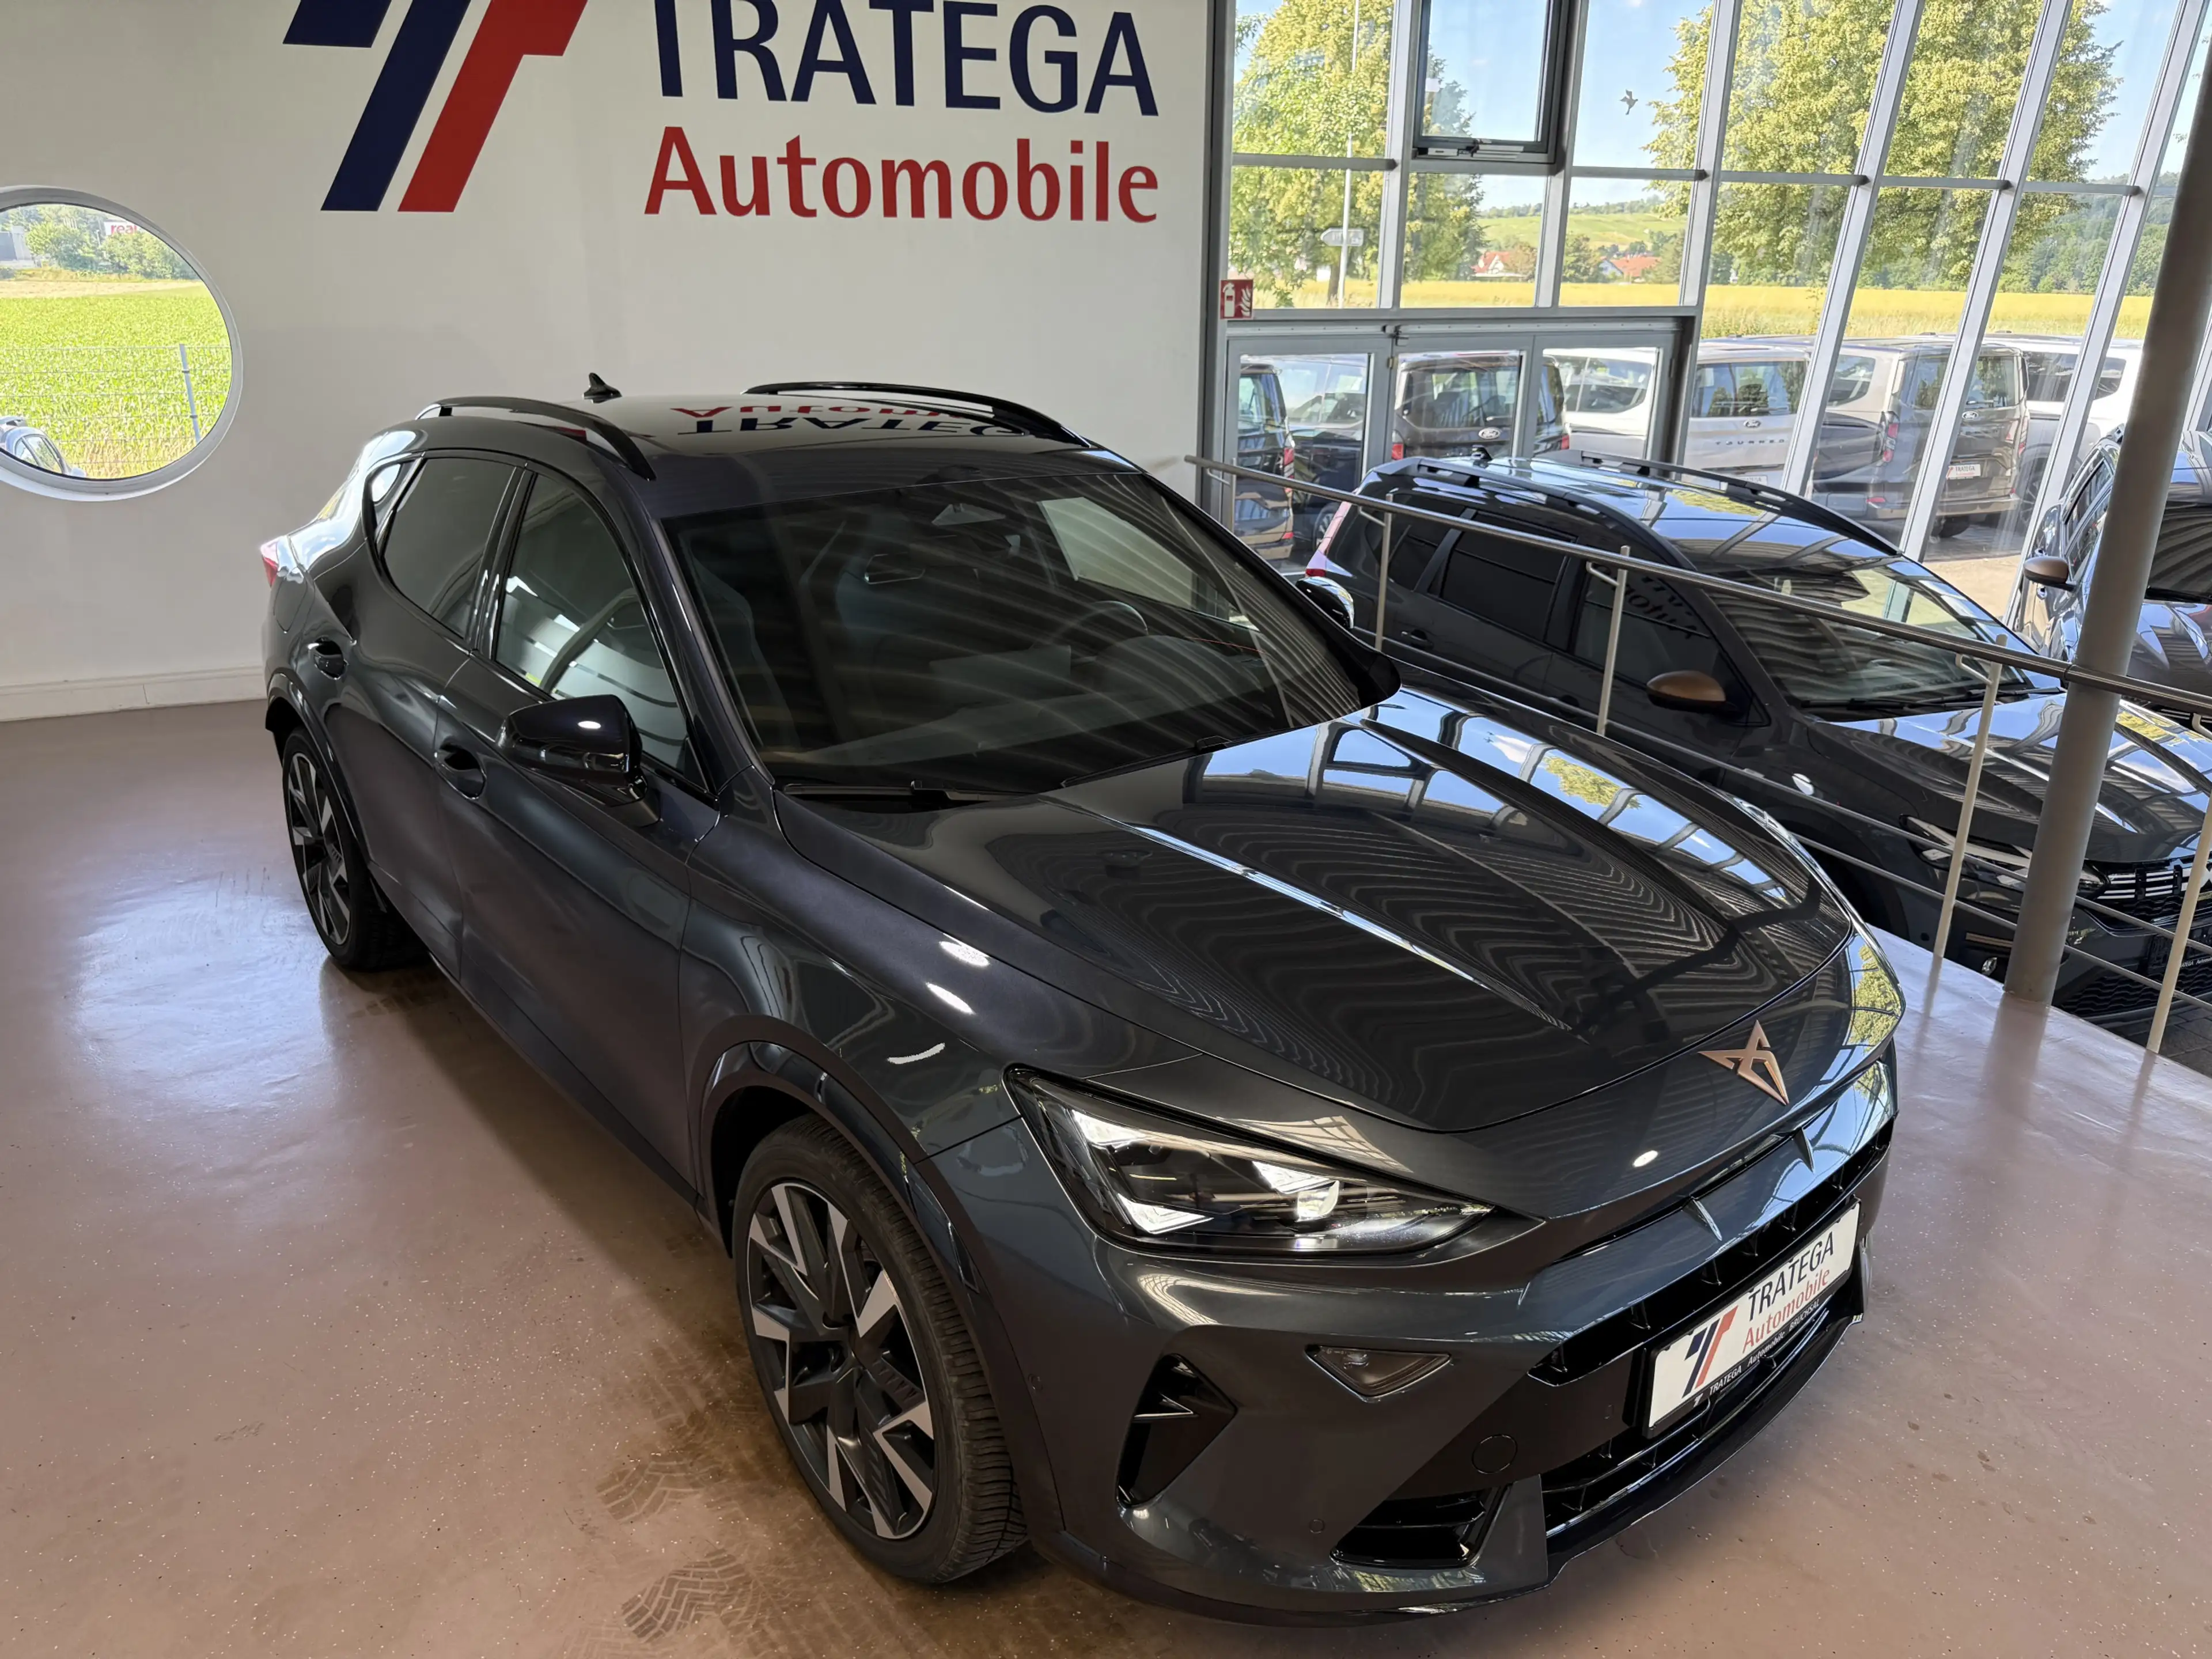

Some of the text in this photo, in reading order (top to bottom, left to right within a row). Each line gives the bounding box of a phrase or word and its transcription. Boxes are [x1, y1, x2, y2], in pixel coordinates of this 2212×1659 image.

[644, 126, 1158, 223] Automobile
[1742, 1268, 1830, 1354] Automobile
[1748, 1231, 1834, 1321] TRATEGA
[1709, 1298, 1820, 1395] TRATEGA Automobile BRUCHSAL
